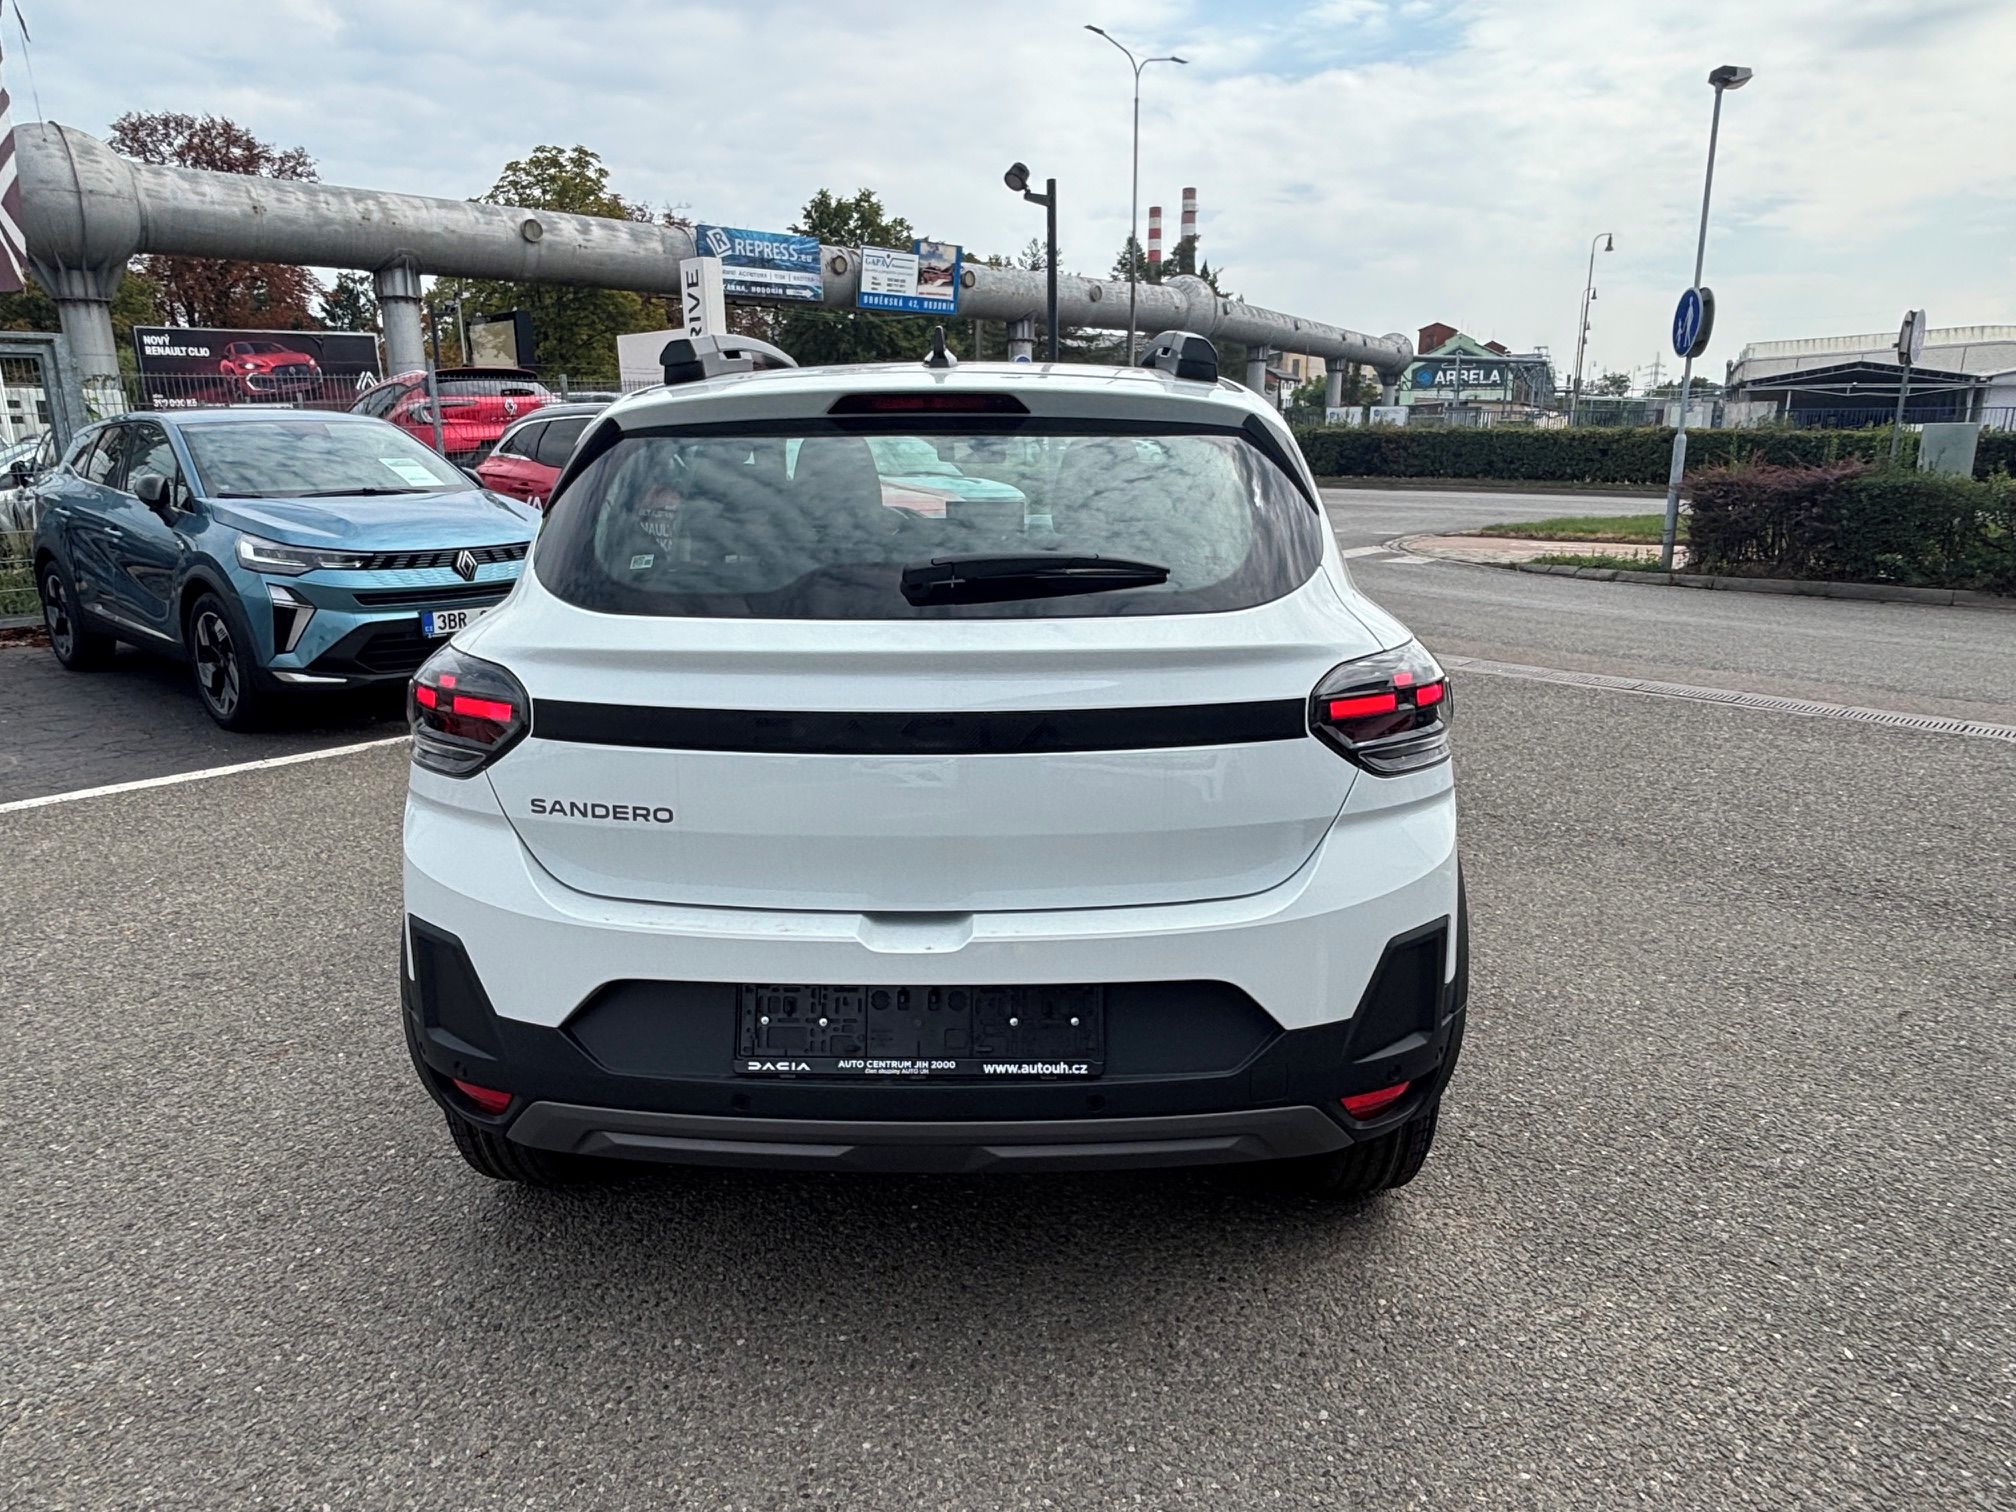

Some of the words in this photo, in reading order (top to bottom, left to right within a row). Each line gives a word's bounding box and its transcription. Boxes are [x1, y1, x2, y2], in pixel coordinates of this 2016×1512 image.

[143, 334, 170, 346] NOVÝ
[145, 346, 187, 357] RENAULT
[188, 347, 210, 358] CLIO
[437, 612, 467, 631] 3BR
[530, 798, 674, 824] SANDERO
[747, 1061, 811, 1071] DACIA
[838, 1059, 865, 1069] AUTO
[866, 1060, 912, 1069] CENTRUM
[914, 1060, 929, 1069] JIH
[930, 1060, 956, 1069] 2000
[983, 1061, 1088, 1075] www.autouh.cz
